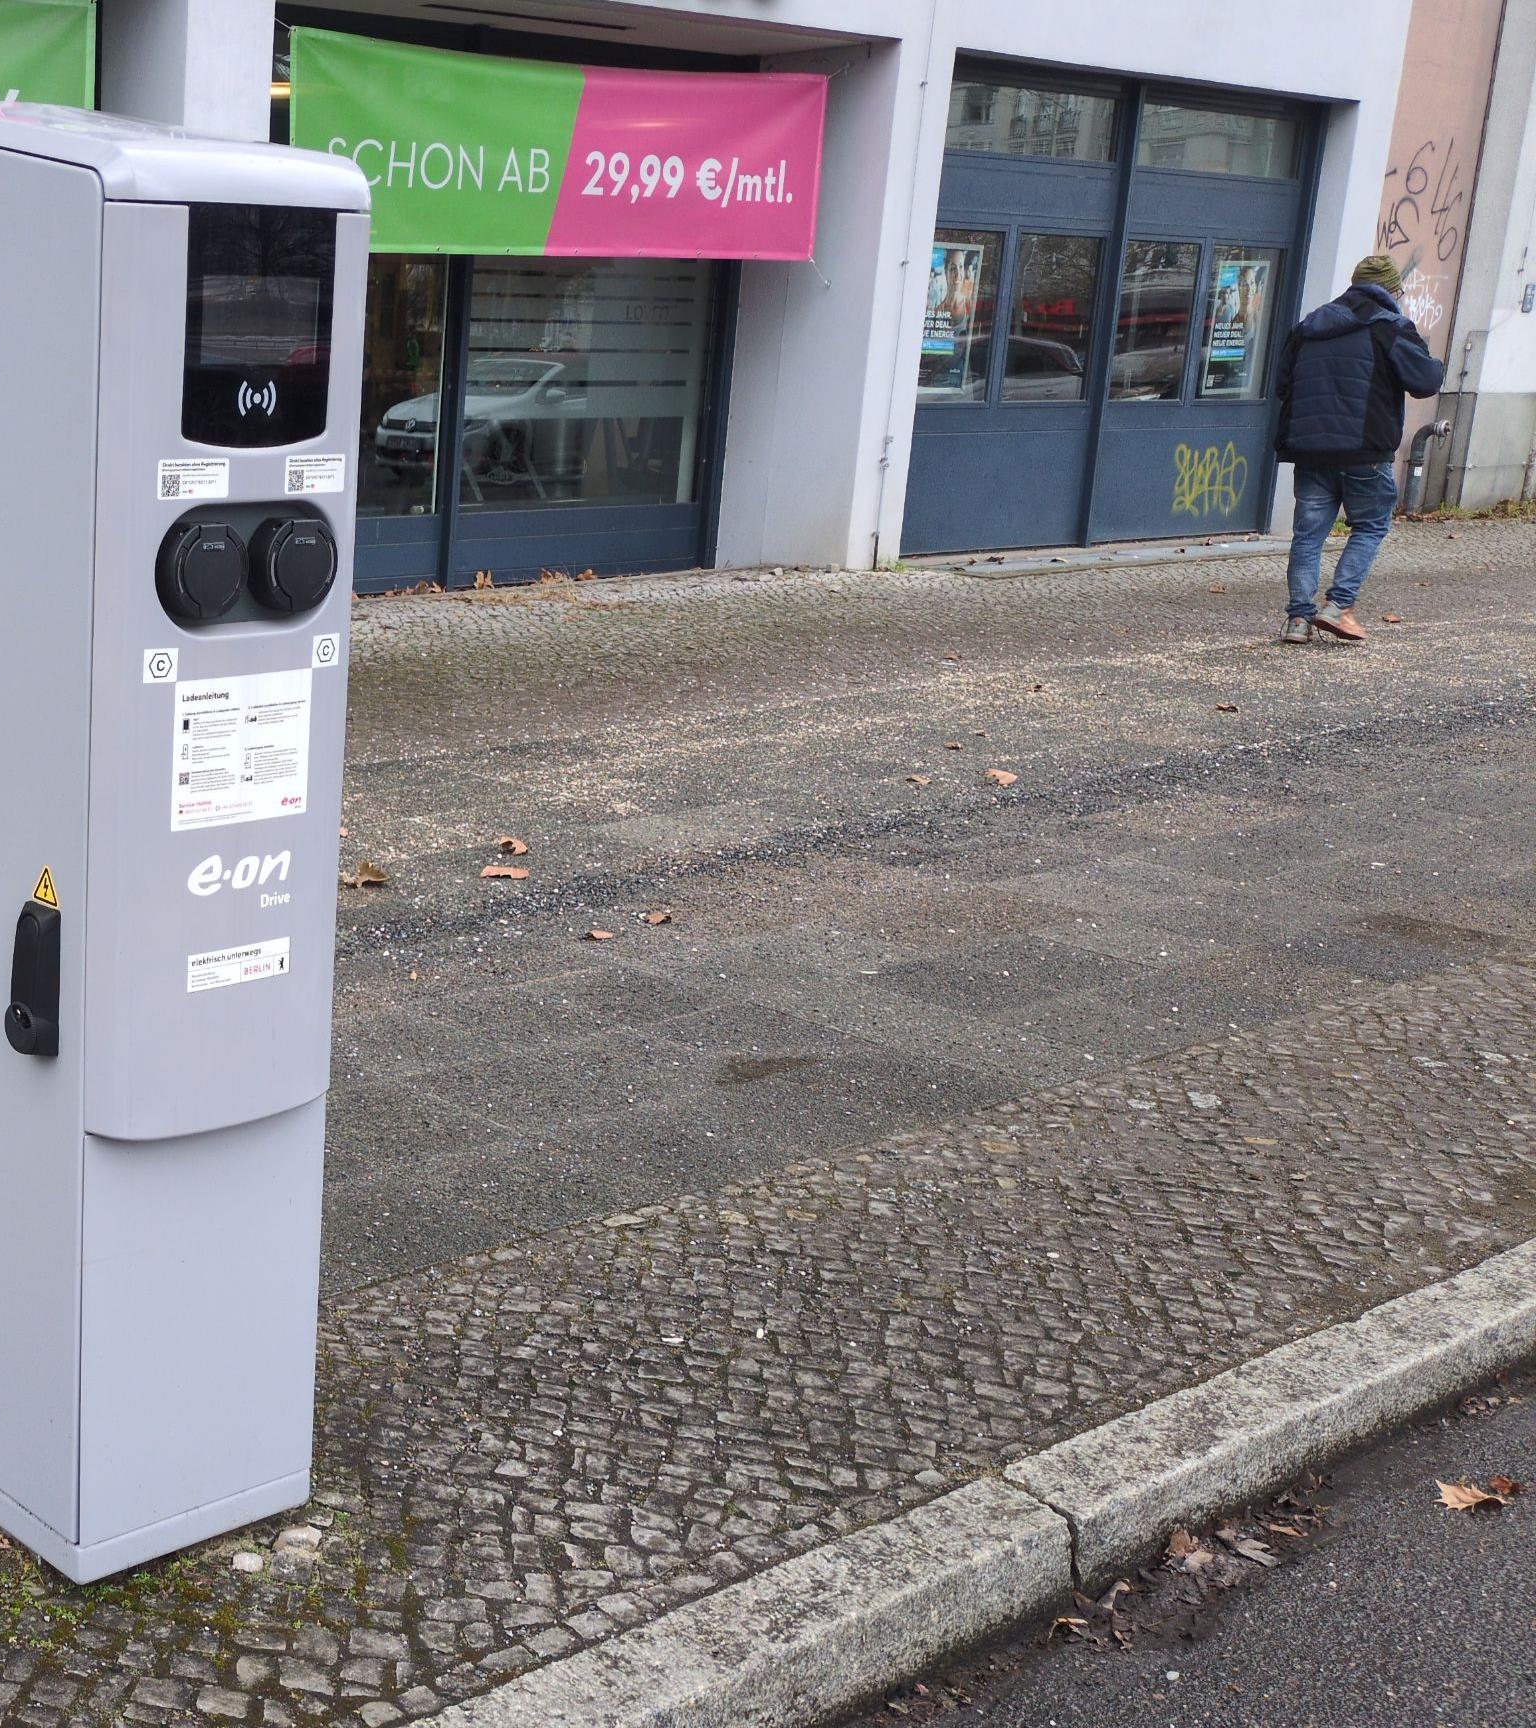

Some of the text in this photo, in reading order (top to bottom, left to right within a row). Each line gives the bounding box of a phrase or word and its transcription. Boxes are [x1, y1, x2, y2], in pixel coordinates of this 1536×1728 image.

[497, 146, 550, 193] AB
[581, 151, 685, 204] 29,99
[695, 157, 793, 208] €/mtl.
[322, 645, 330, 656] C
[156, 660, 166, 671] C
[260, 892, 291, 908] Drive
[191, 954, 226, 967] elektrisch
[243, 962, 271, 976] BERLIN
